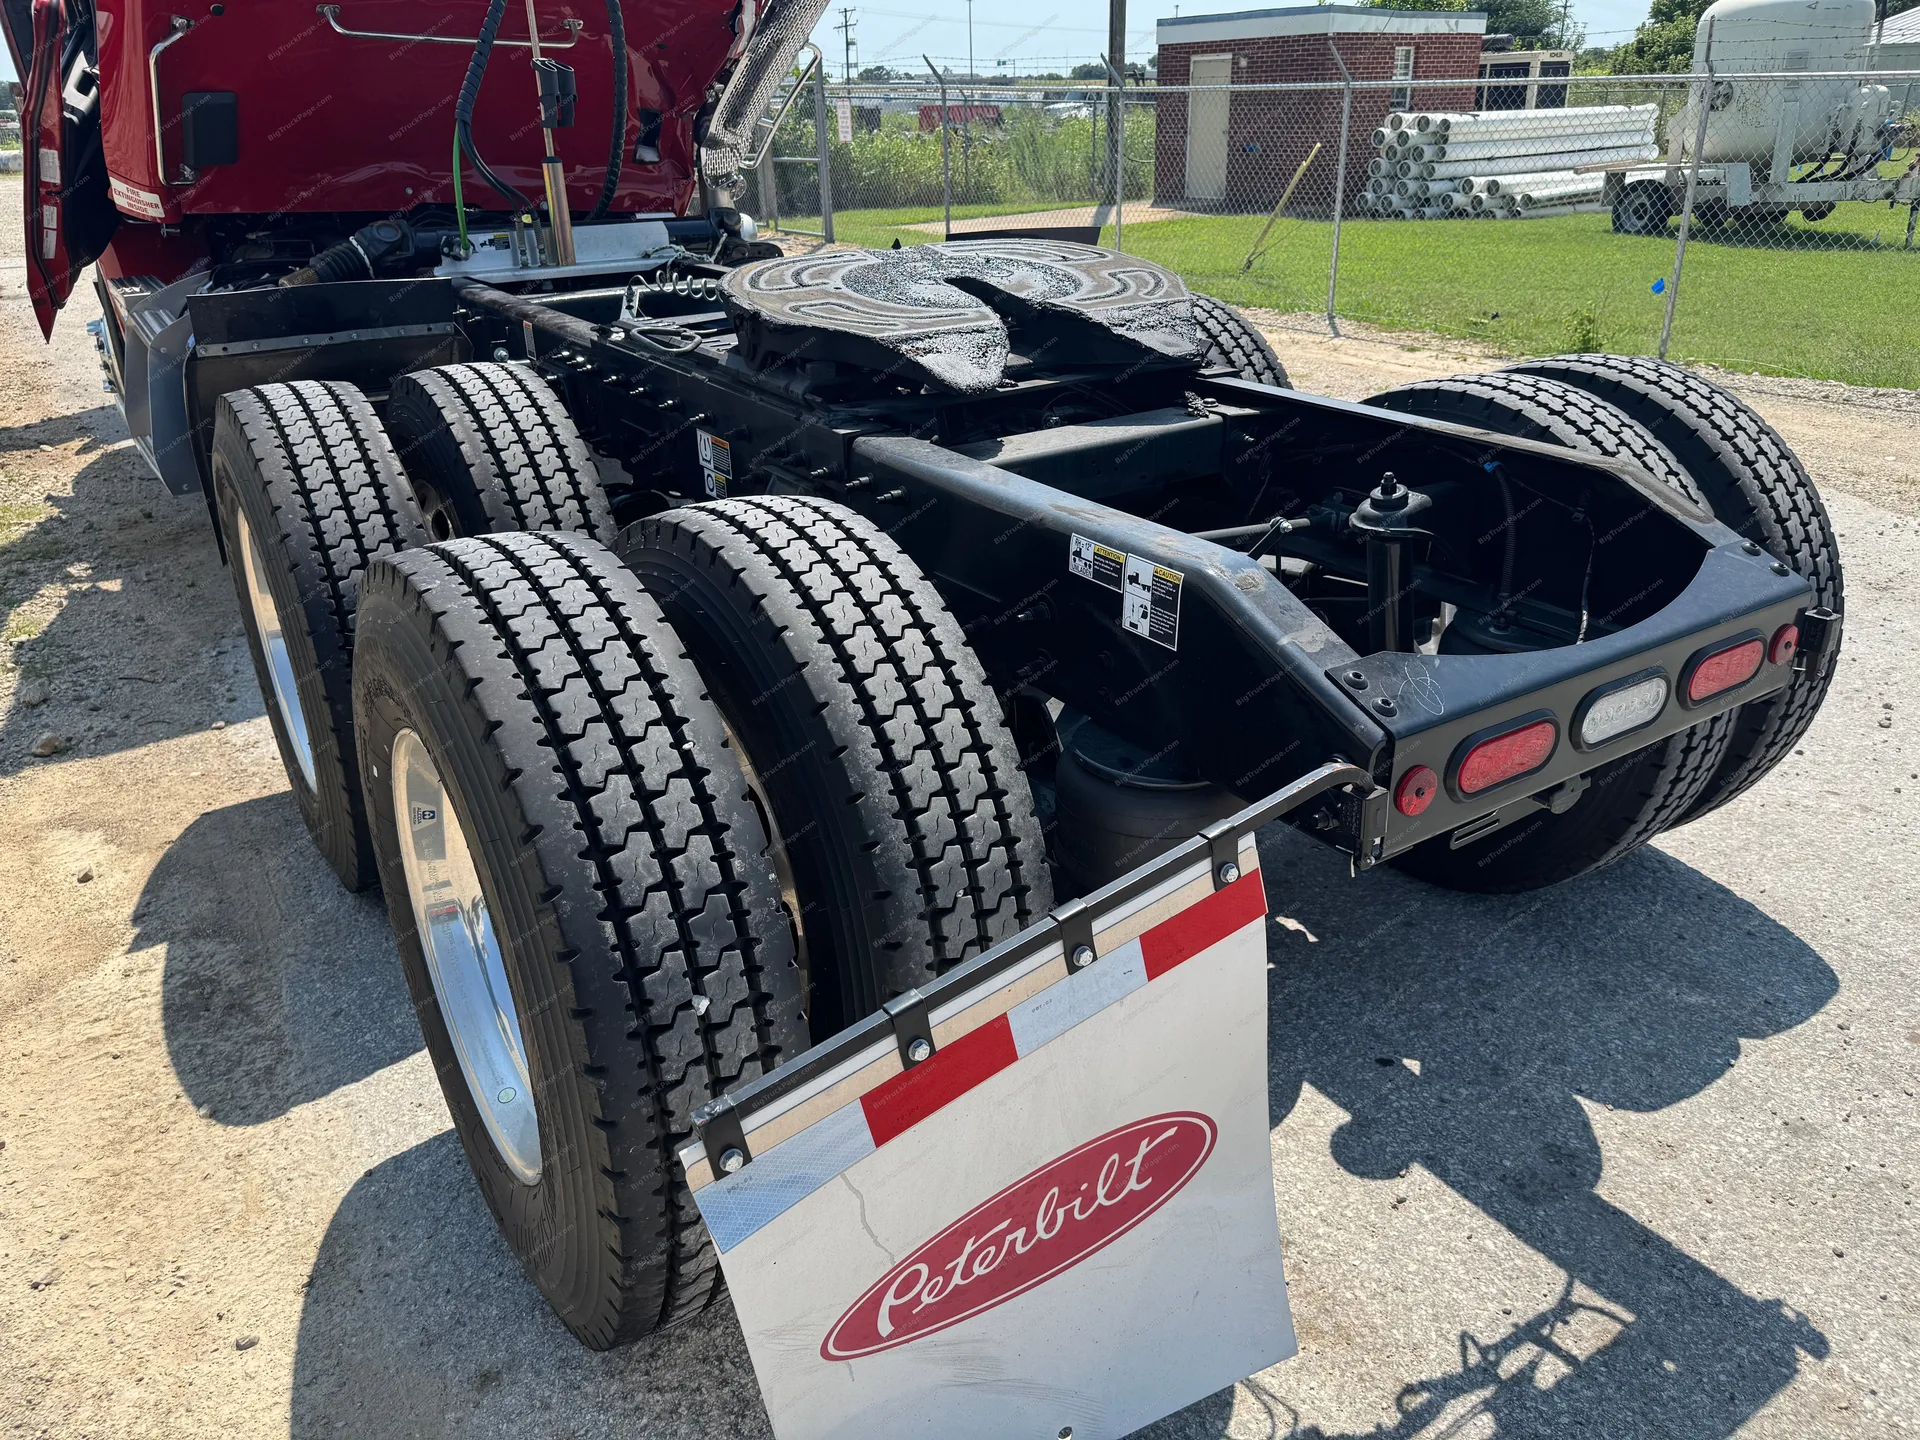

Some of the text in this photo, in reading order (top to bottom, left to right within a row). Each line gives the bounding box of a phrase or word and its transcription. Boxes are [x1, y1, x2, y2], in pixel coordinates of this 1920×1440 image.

[114, 188, 160, 210] EXTINGUISHER
[126, 187, 142, 198] FIRE
[126, 202, 149, 214] INSIDE
[1096, 547, 1122, 561] ATTENTION
[1158, 568, 1182, 582] CAUTION
[877, 1127, 1178, 1338] Peterbilt
